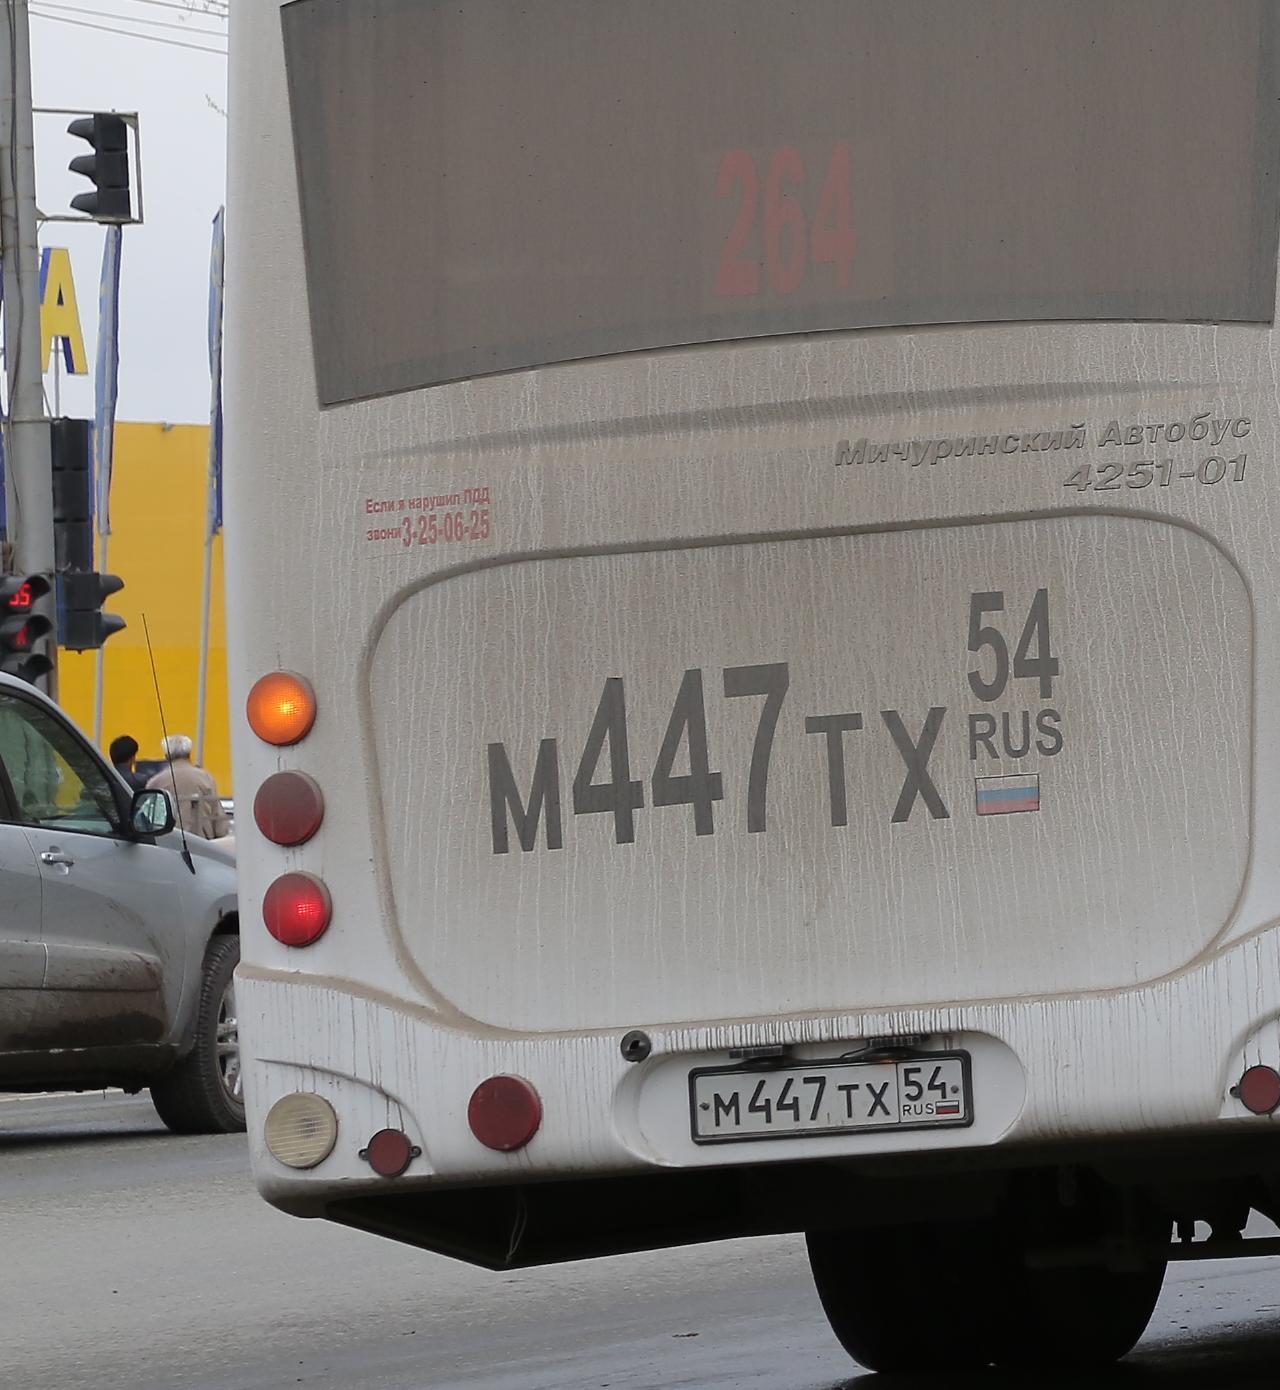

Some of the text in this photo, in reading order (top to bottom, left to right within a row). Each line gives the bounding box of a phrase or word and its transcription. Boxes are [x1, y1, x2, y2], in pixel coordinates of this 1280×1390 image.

[716, 138, 857, 295] 264
[835, 412, 1252, 467] Мичуринский Автобус
[1063, 454, 1249, 492] 4251-01
[366, 487, 490, 513] Если я нарушил ПДД
[367, 509, 490, 547] звони 3-25-06-25
[967, 588, 1060, 702] 54
[968, 708, 1064, 761] RUS
[903, 1066, 947, 1102] 54
[902, 1103, 934, 1117] RUS
